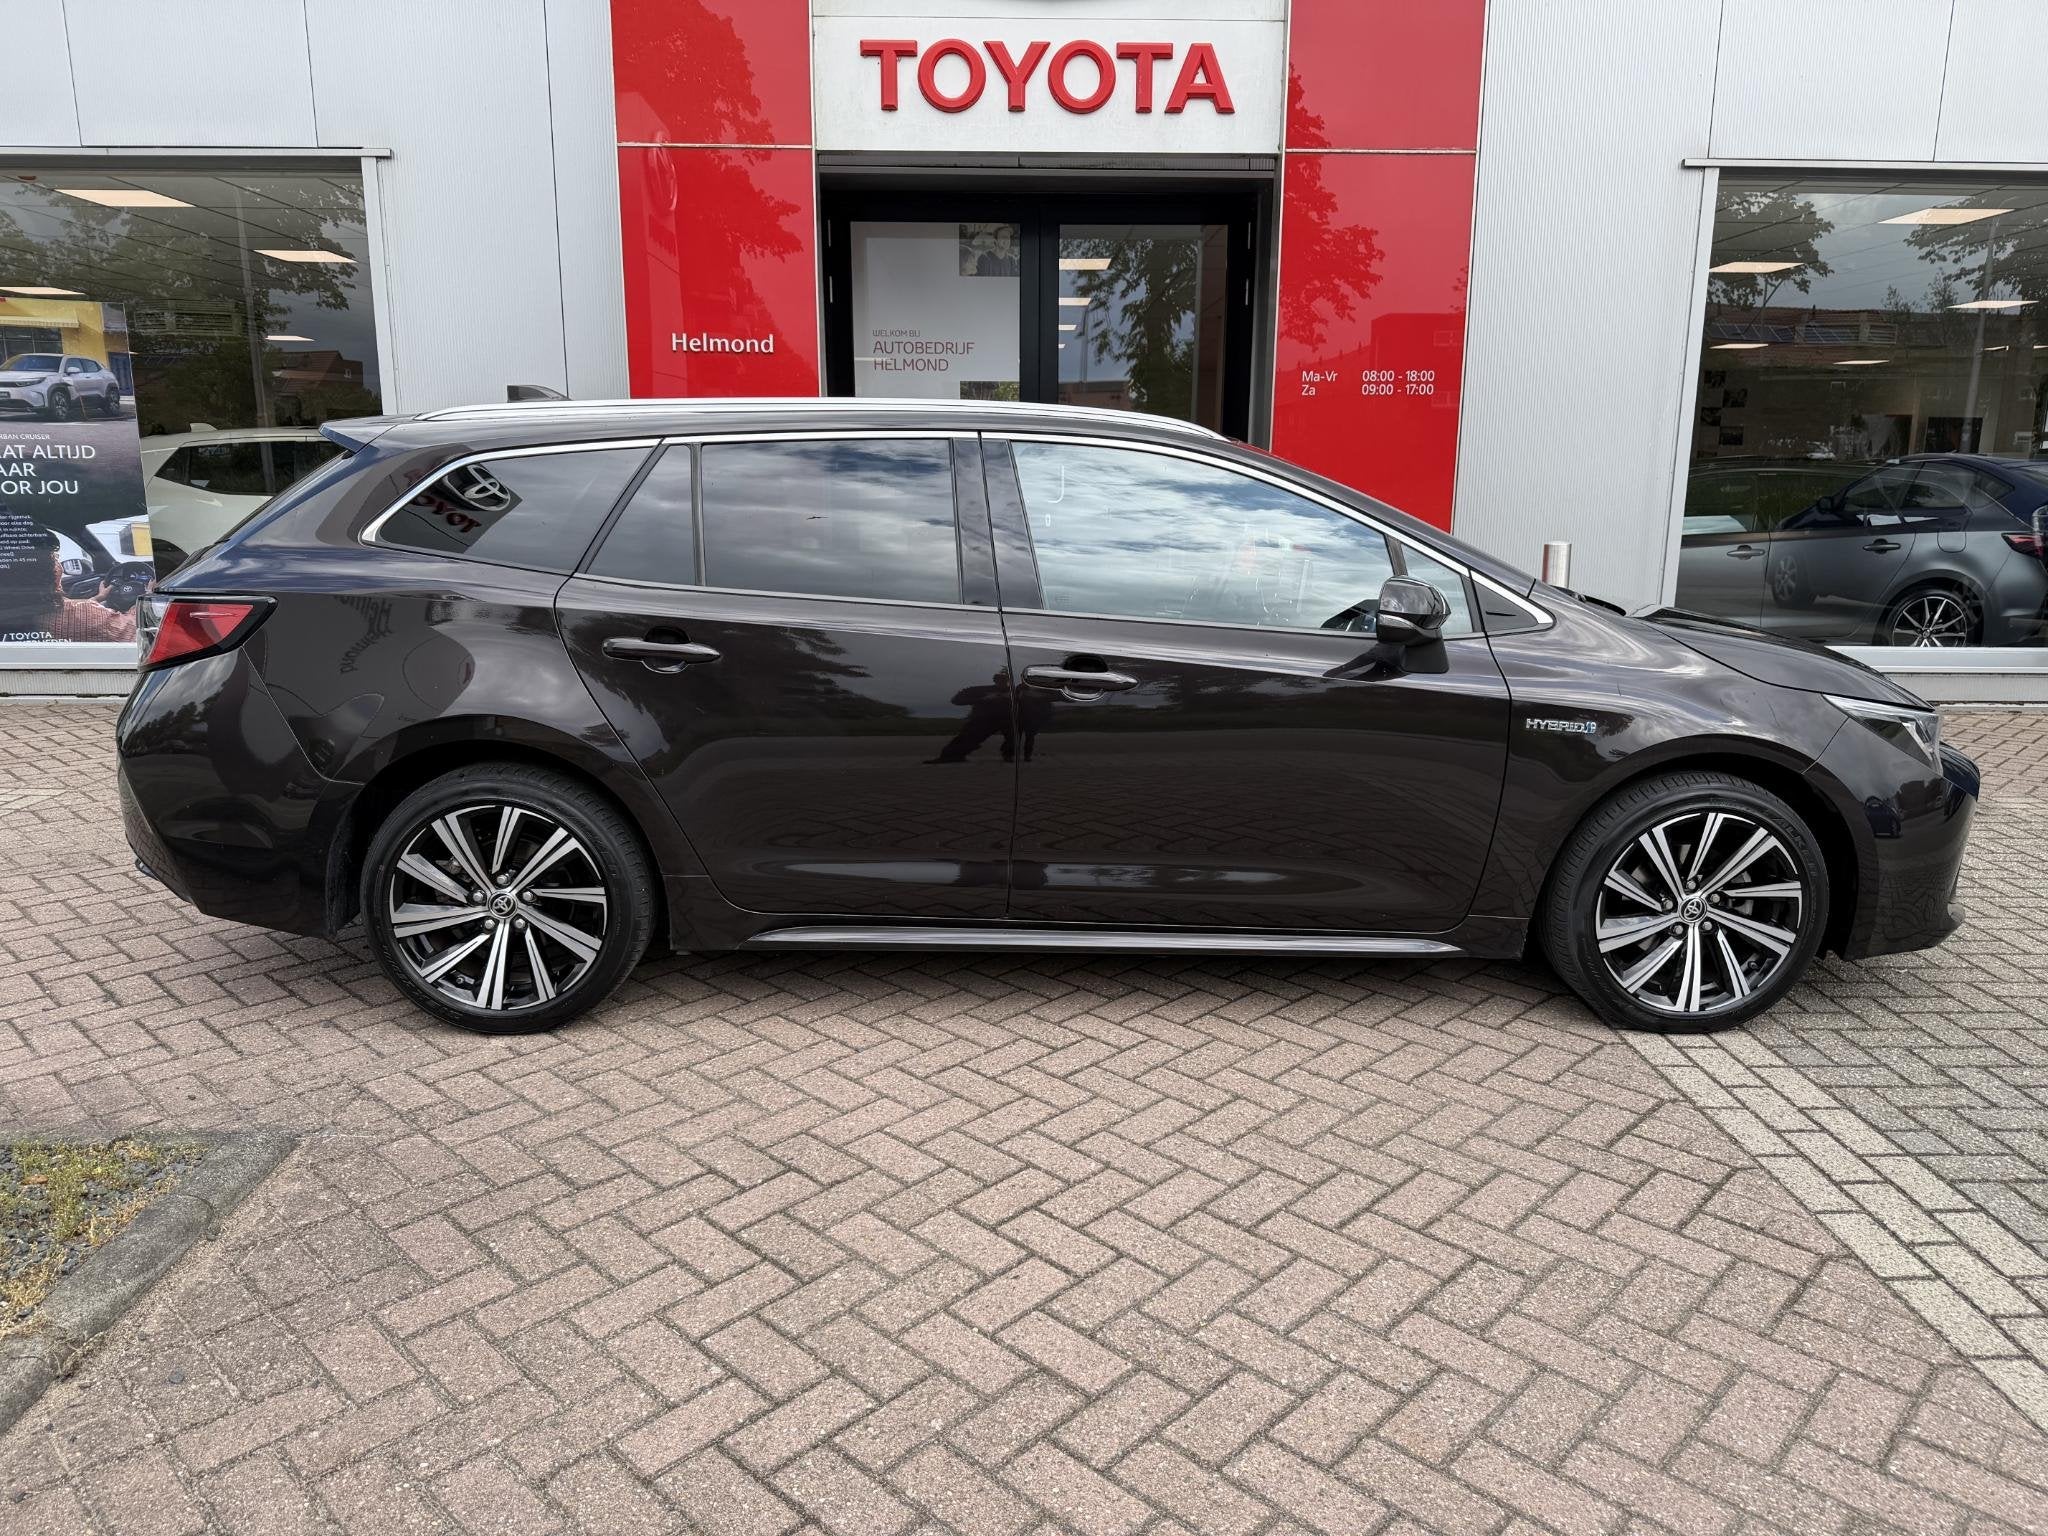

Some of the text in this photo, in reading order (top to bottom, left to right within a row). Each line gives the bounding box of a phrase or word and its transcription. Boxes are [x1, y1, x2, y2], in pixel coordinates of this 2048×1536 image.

[859, 37, 1235, 114] TOYOTA
[872, 329, 908, 337] WELKOM
[671, 332, 774, 353] Helmond
[873, 340, 976, 355] AUTOBEDRIJF
[873, 358, 949, 371] HELMOND
[1302, 370, 1338, 382] Ma-Vr
[1362, 370, 1395, 382] 08:00
[1405, 370, 1435, 382] 18:00
[1302, 384, 1316, 396] Za
[1361, 384, 1394, 396] 09:00
[1405, 384, 1434, 396] 17:00
[0, 444, 96, 459] AT ALTIJD
[1, 480, 79, 495] OR JOU
[9, 631, 54, 641] TOYOTA
[1525, 718, 1586, 733] HYBRID
